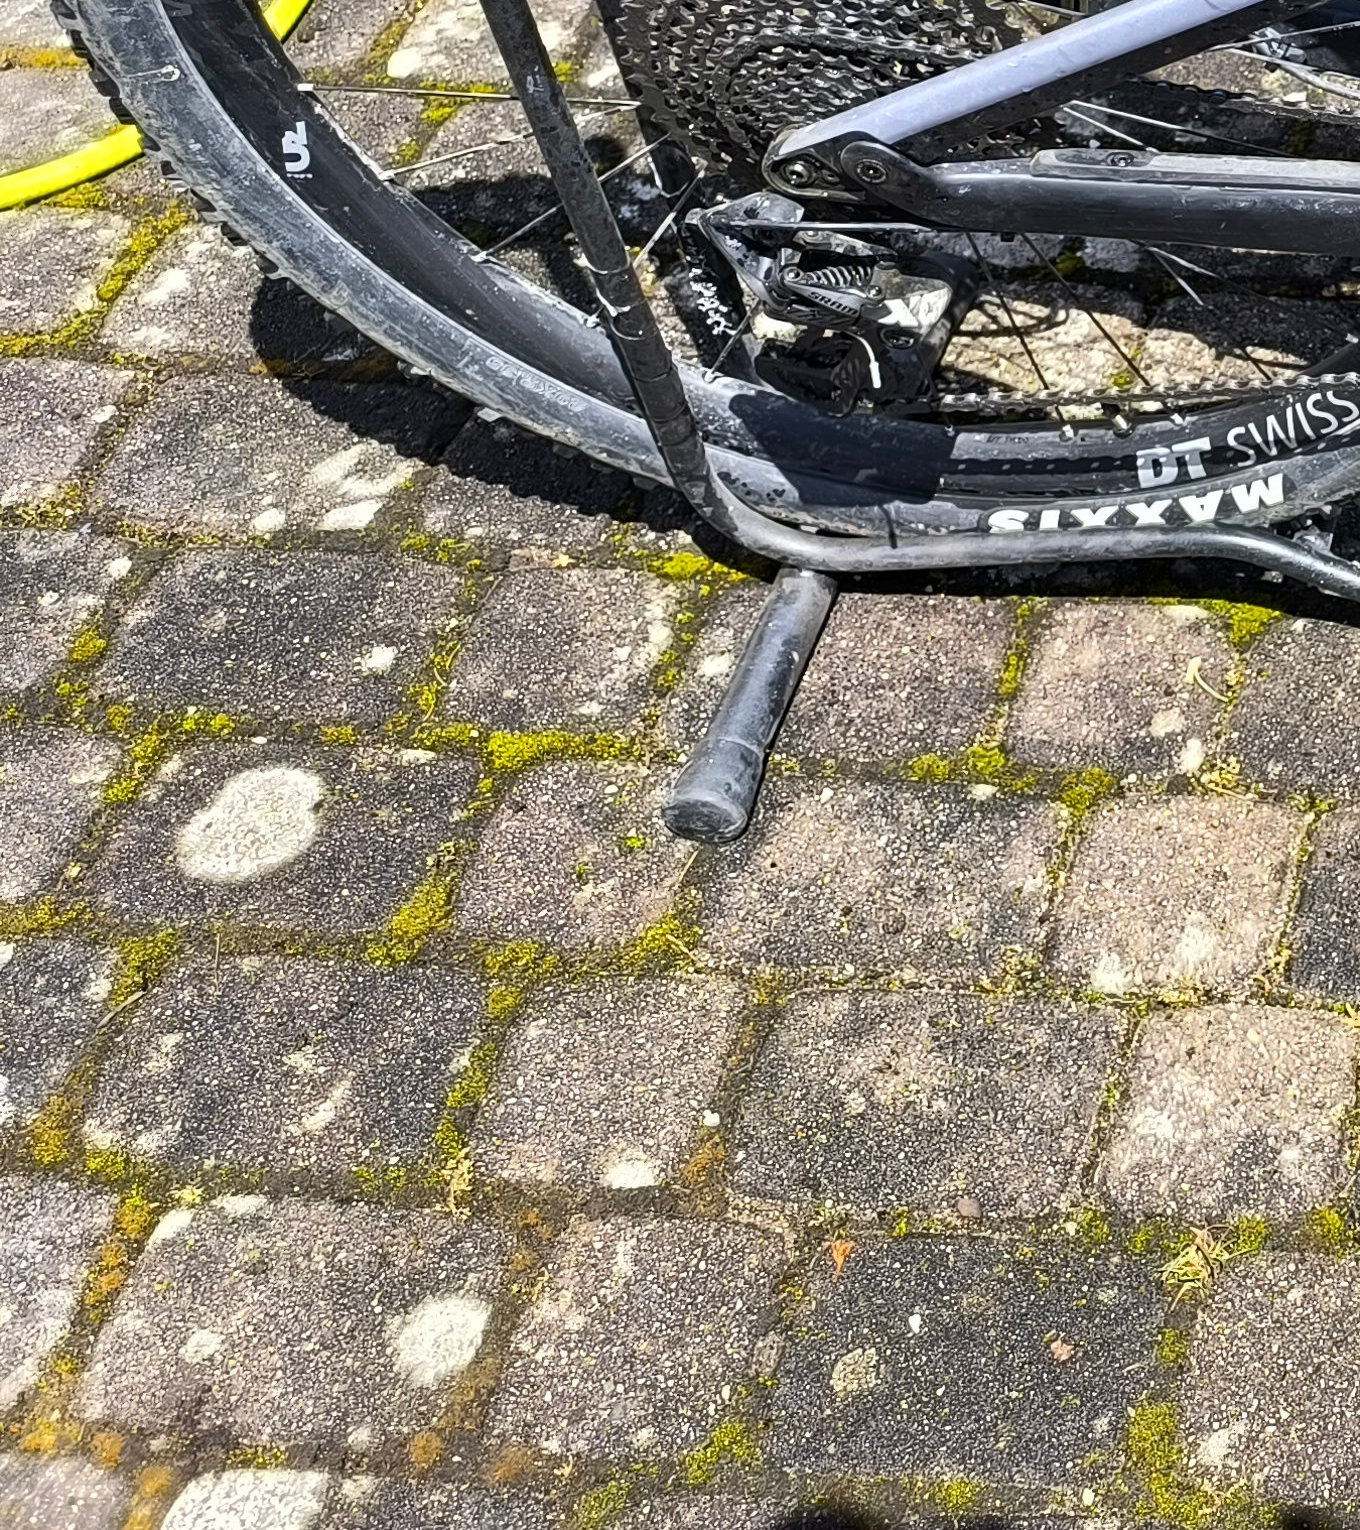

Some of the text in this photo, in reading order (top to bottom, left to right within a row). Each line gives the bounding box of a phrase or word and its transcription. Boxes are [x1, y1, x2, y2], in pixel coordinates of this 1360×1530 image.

[807, 290, 859, 317] SRAM
[1136, 389, 1360, 490] DT SWISS
[987, 472, 1286, 535] MAXXIS
